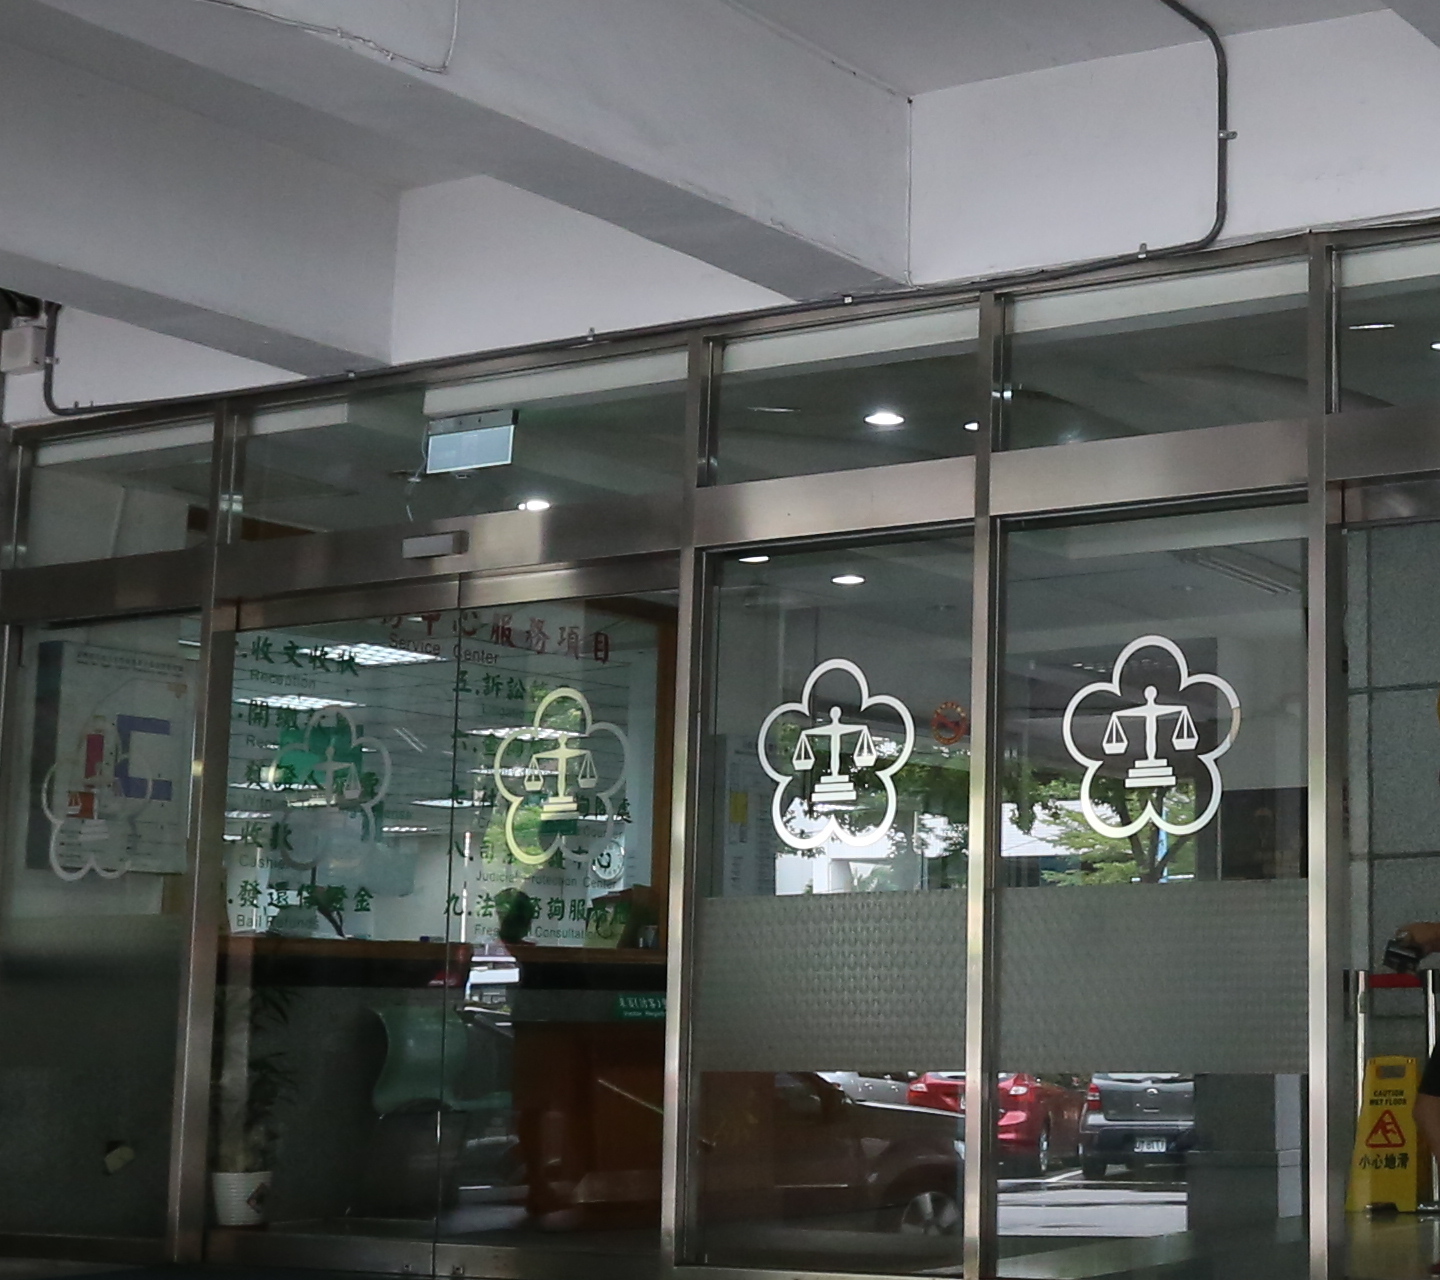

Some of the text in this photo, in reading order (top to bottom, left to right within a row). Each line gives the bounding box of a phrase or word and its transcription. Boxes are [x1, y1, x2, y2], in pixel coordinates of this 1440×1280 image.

[389, 632, 500, 665] Service Center
[1373, 1089, 1404, 1098] CAUTION
[1369, 1098, 1407, 1106] WET FLOOR
[1359, 1152, 1409, 1170] 小心地滑
